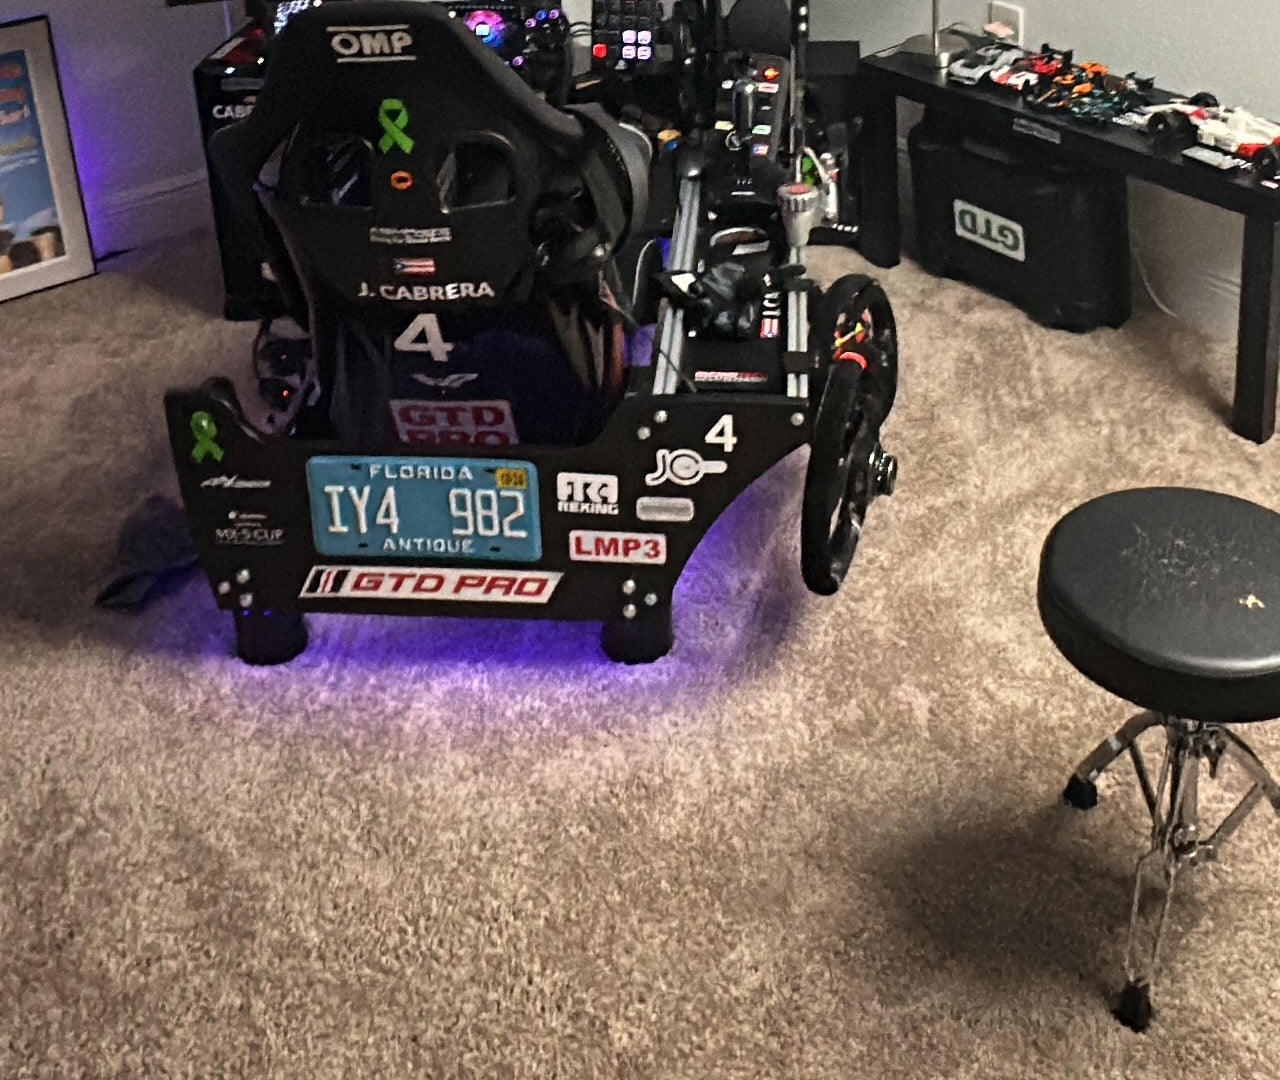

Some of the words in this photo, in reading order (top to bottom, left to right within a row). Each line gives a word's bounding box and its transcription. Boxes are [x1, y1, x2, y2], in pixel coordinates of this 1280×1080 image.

[330, 29, 413, 57] OMP
[958, 209, 1020, 252] GTD
[378, 281, 496, 302] CABRERA
[393, 312, 455, 362] 4
[398, 405, 506, 427] GTD
[704, 414, 738, 452] 4
[369, 463, 473, 481] FLORIDA
[323, 485, 400, 534] IY4
[448, 487, 528, 539] 982
[382, 537, 477, 554] ANTIQUE
[574, 536, 662, 559] LMP3
[351, 572, 449, 594] GTD
[452, 574, 549, 597] PRO
